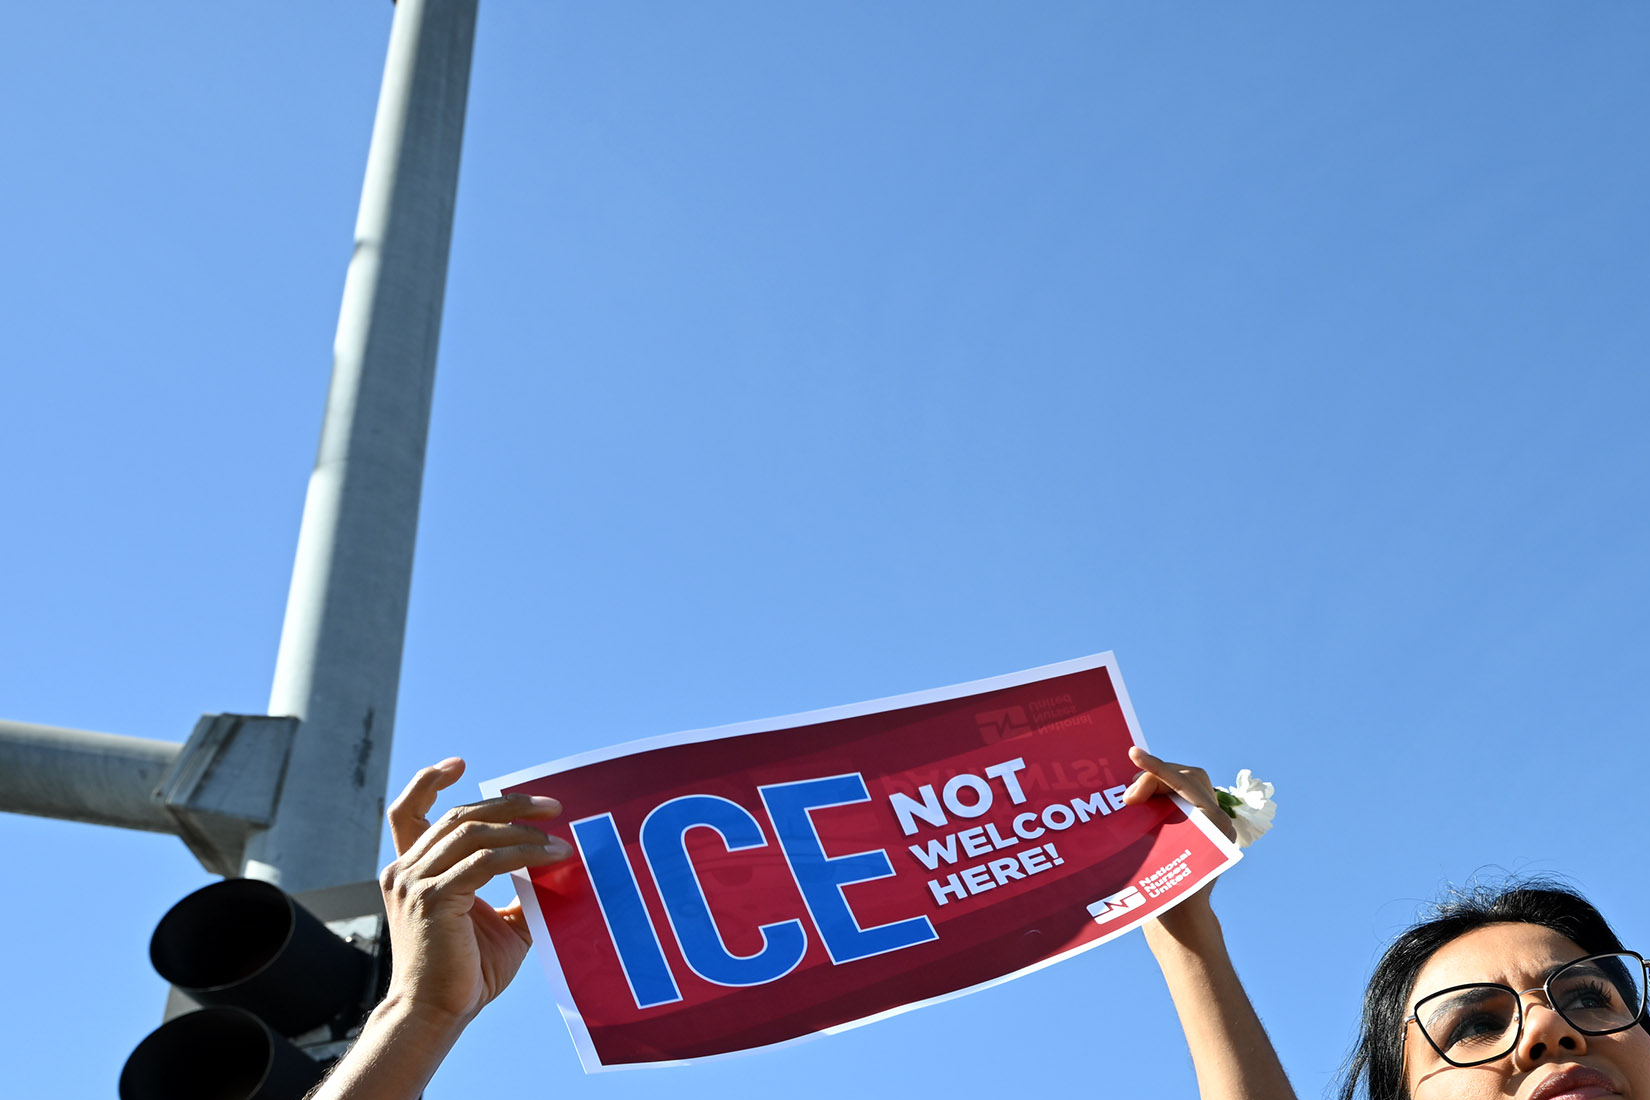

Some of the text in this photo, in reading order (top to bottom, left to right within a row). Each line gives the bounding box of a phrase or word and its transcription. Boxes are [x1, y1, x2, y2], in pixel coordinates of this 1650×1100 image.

[887, 755, 1027, 837] NOT
[908, 783, 1128, 872] WELCOME
[569, 772, 938, 1009] ICE
[927, 841, 1065, 906] HERE!
[1139, 849, 1192, 887] National
[1144, 862, 1188, 893] Nurses
[1149, 867, 1192, 898] United
